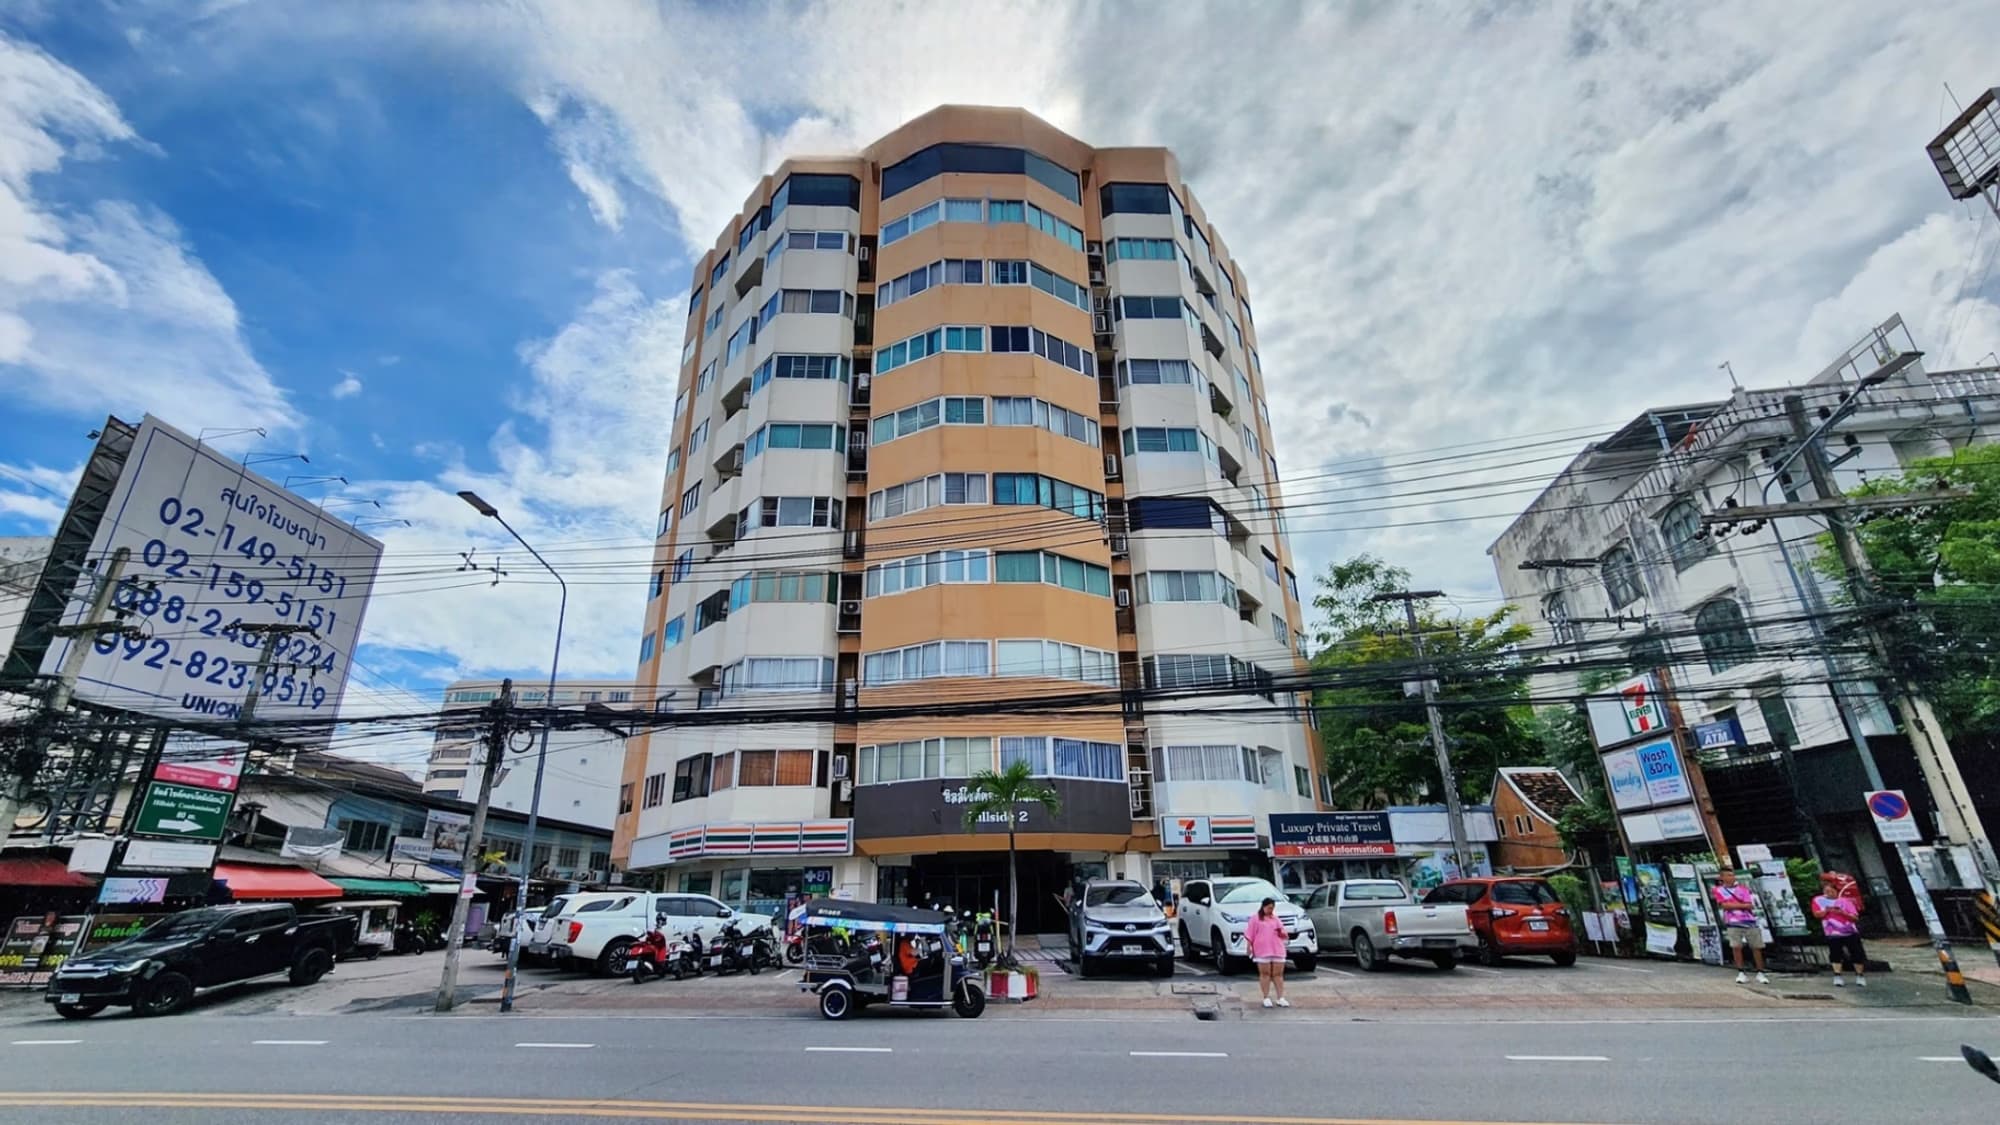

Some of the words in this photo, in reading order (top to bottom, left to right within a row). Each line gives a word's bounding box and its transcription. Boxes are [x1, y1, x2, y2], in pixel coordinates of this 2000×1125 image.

[220, 487, 326, 550] สนใจโฆษณา
[159, 497, 346, 599] 02-149-5151
[143, 539, 336, 635] 02-159-5151
[1705, 731, 1728, 745] ATM
[1640, 750, 1668, 763] Wash
[1650, 762, 1673, 776] &Dry
[1018, 810, 1029, 822] 2
[1280, 823, 1314, 834] Luxury
[1317, 821, 1349, 833] Private
[1350, 821, 1382, 832] Travel
[1298, 845, 1329, 855] Tourist
[1333, 844, 1384, 854] Information
